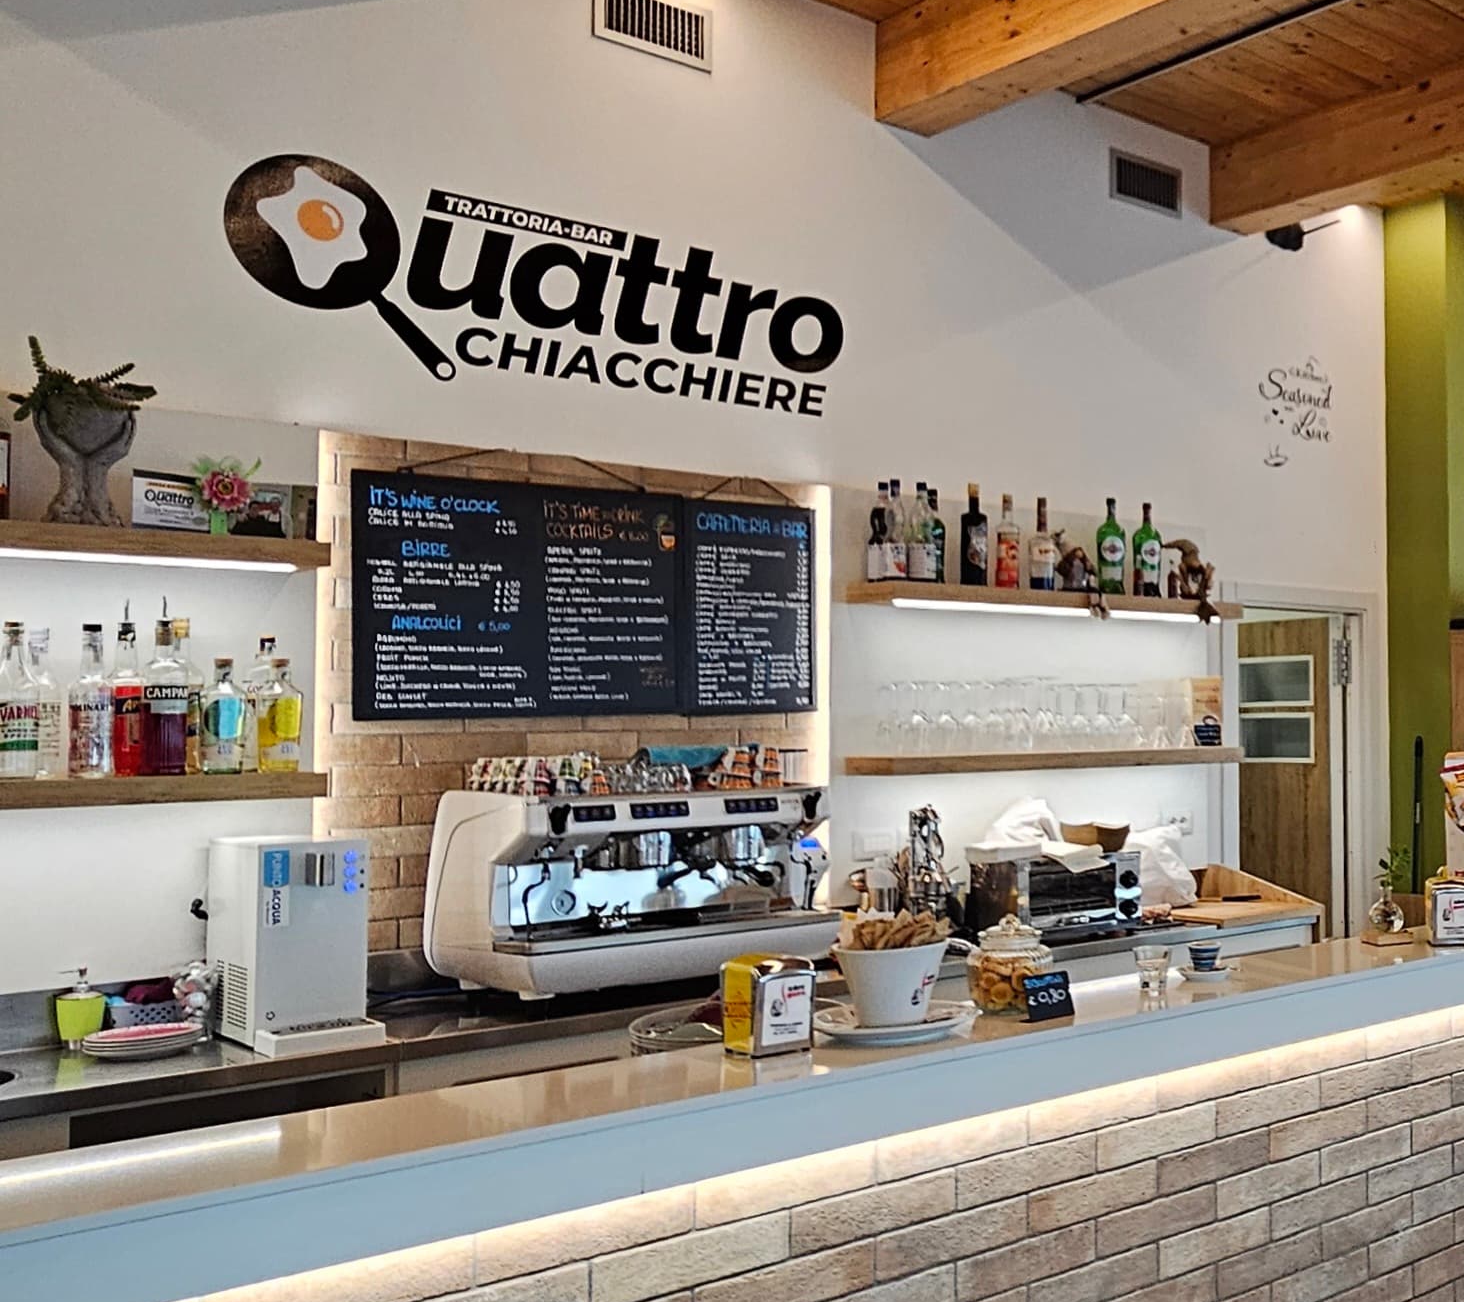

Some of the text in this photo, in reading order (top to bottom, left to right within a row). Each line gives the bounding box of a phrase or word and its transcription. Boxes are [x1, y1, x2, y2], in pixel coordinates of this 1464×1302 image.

[455, 327, 827, 417] CHIACCHIERE
[440, 495, 501, 514] O'CLOCK
[781, 519, 809, 539] BAR
[271, 888, 281, 926] ACQUA
